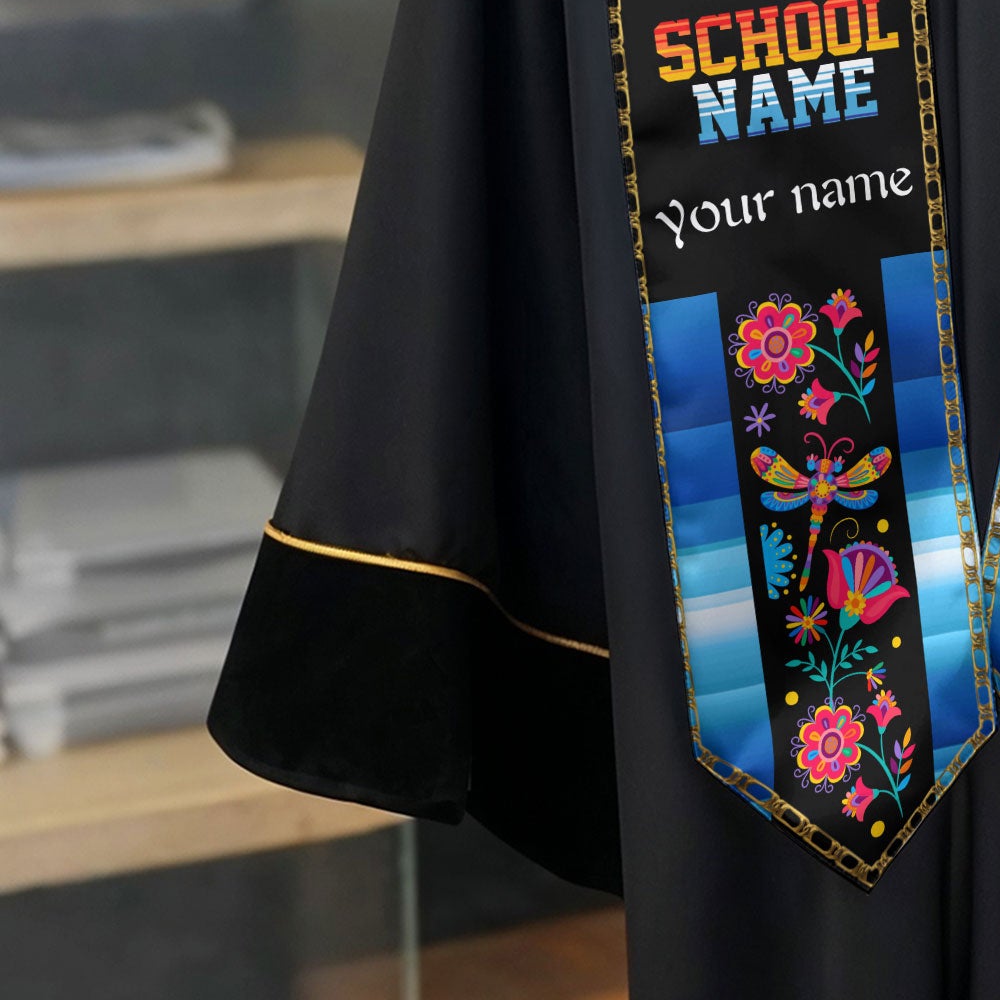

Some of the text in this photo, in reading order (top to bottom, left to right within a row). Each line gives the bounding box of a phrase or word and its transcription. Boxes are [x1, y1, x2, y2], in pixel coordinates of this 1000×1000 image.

[692, 57, 879, 145] NAME
[655, 167, 913, 249] your name
